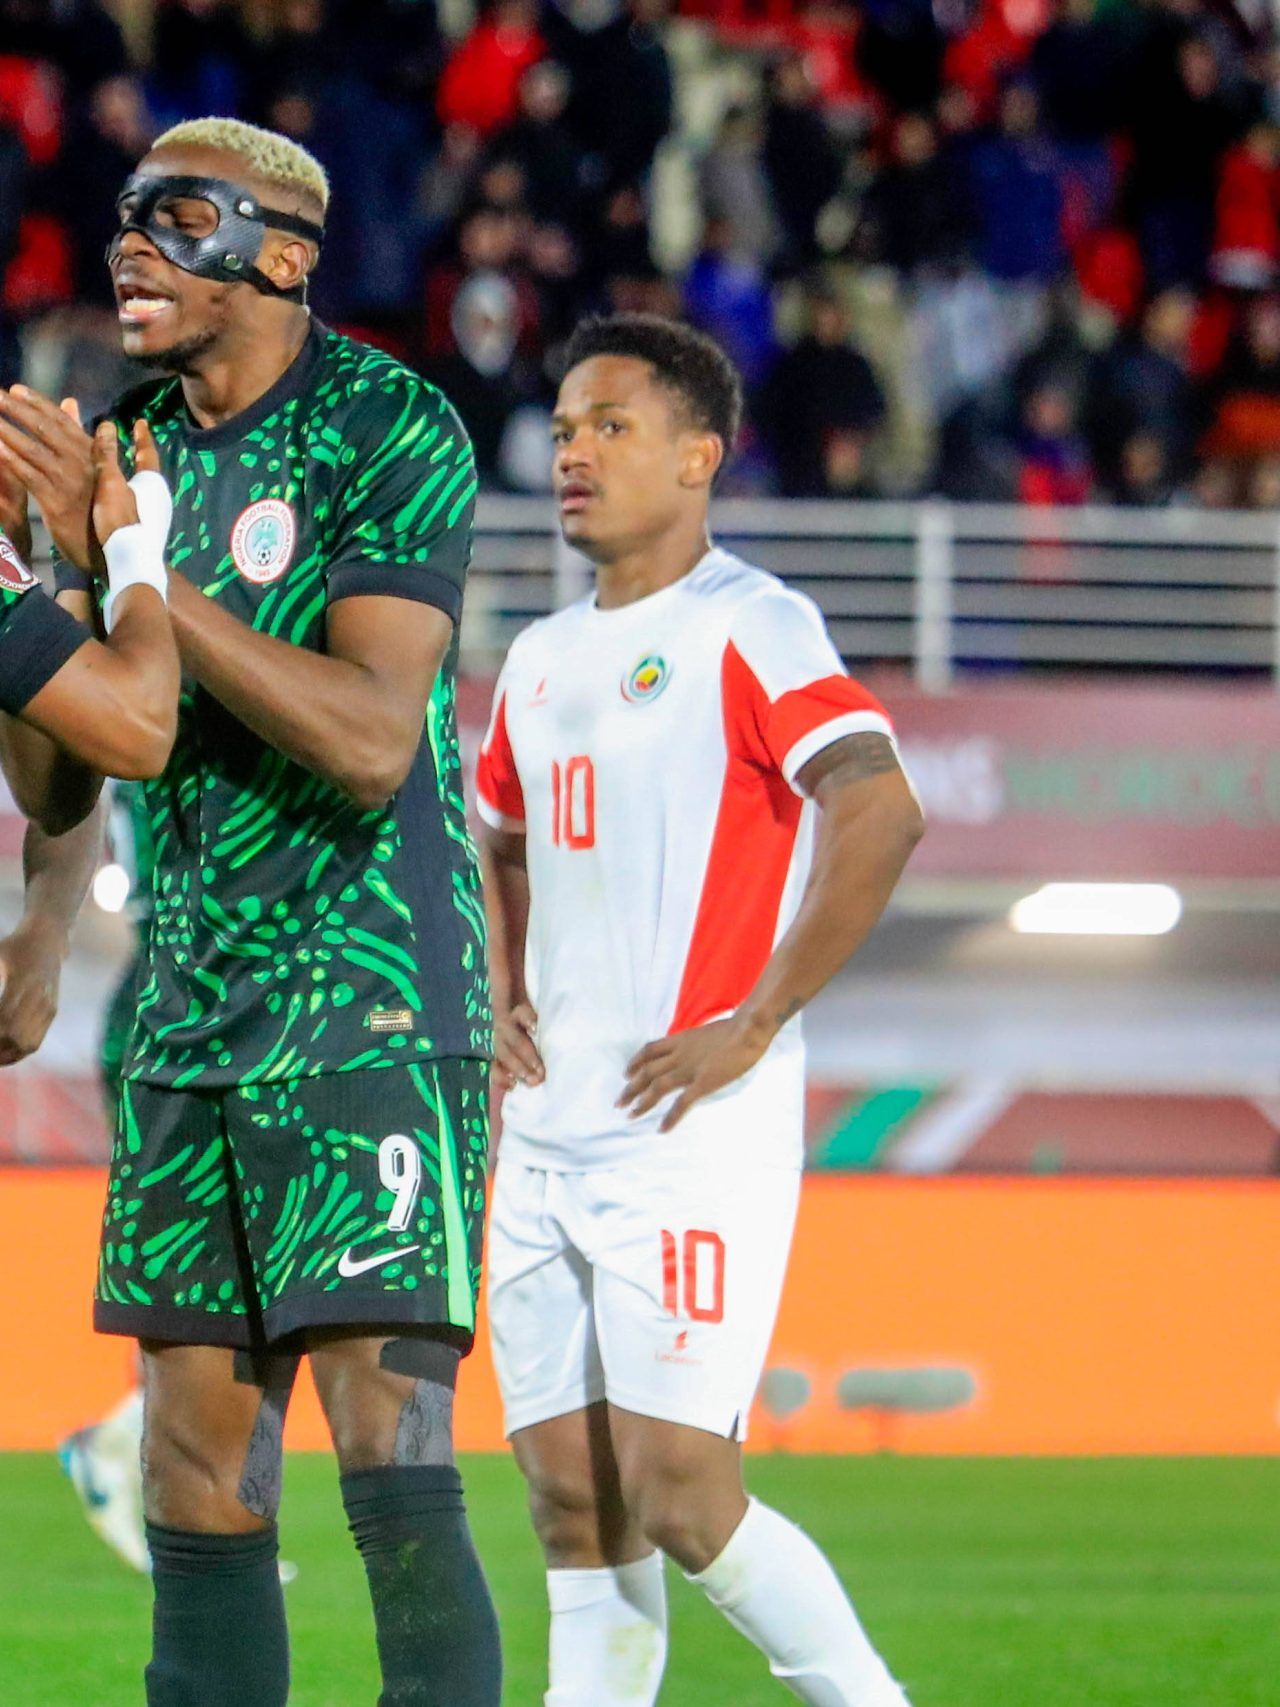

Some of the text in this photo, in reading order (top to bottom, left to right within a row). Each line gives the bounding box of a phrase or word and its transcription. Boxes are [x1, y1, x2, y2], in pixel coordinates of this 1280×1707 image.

[552, 754, 595, 850] 10
[378, 1134, 421, 1231] 9
[660, 1229, 726, 1324] 10
